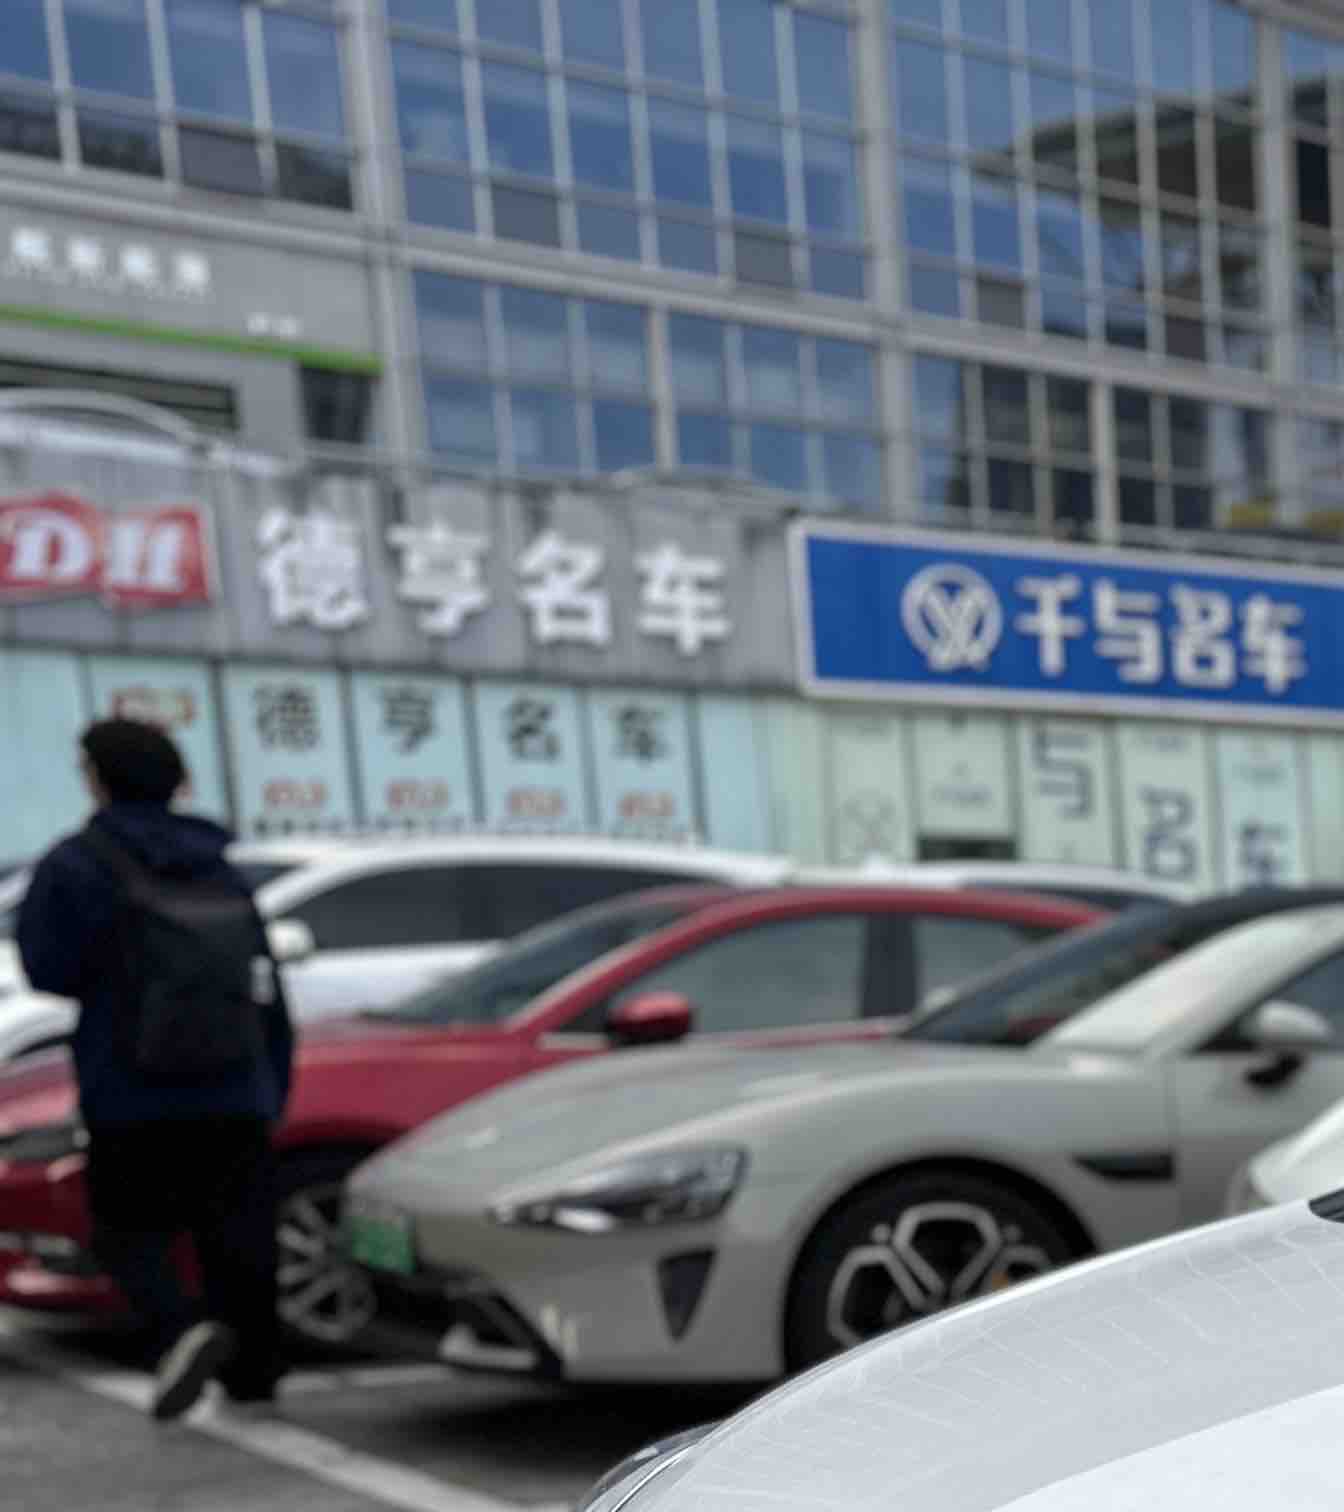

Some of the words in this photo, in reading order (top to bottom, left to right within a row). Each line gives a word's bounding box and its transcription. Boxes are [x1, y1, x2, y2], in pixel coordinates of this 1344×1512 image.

[258, 505, 733, 656] 德亨名车
[1012, 572, 1308, 694] 千与名车
